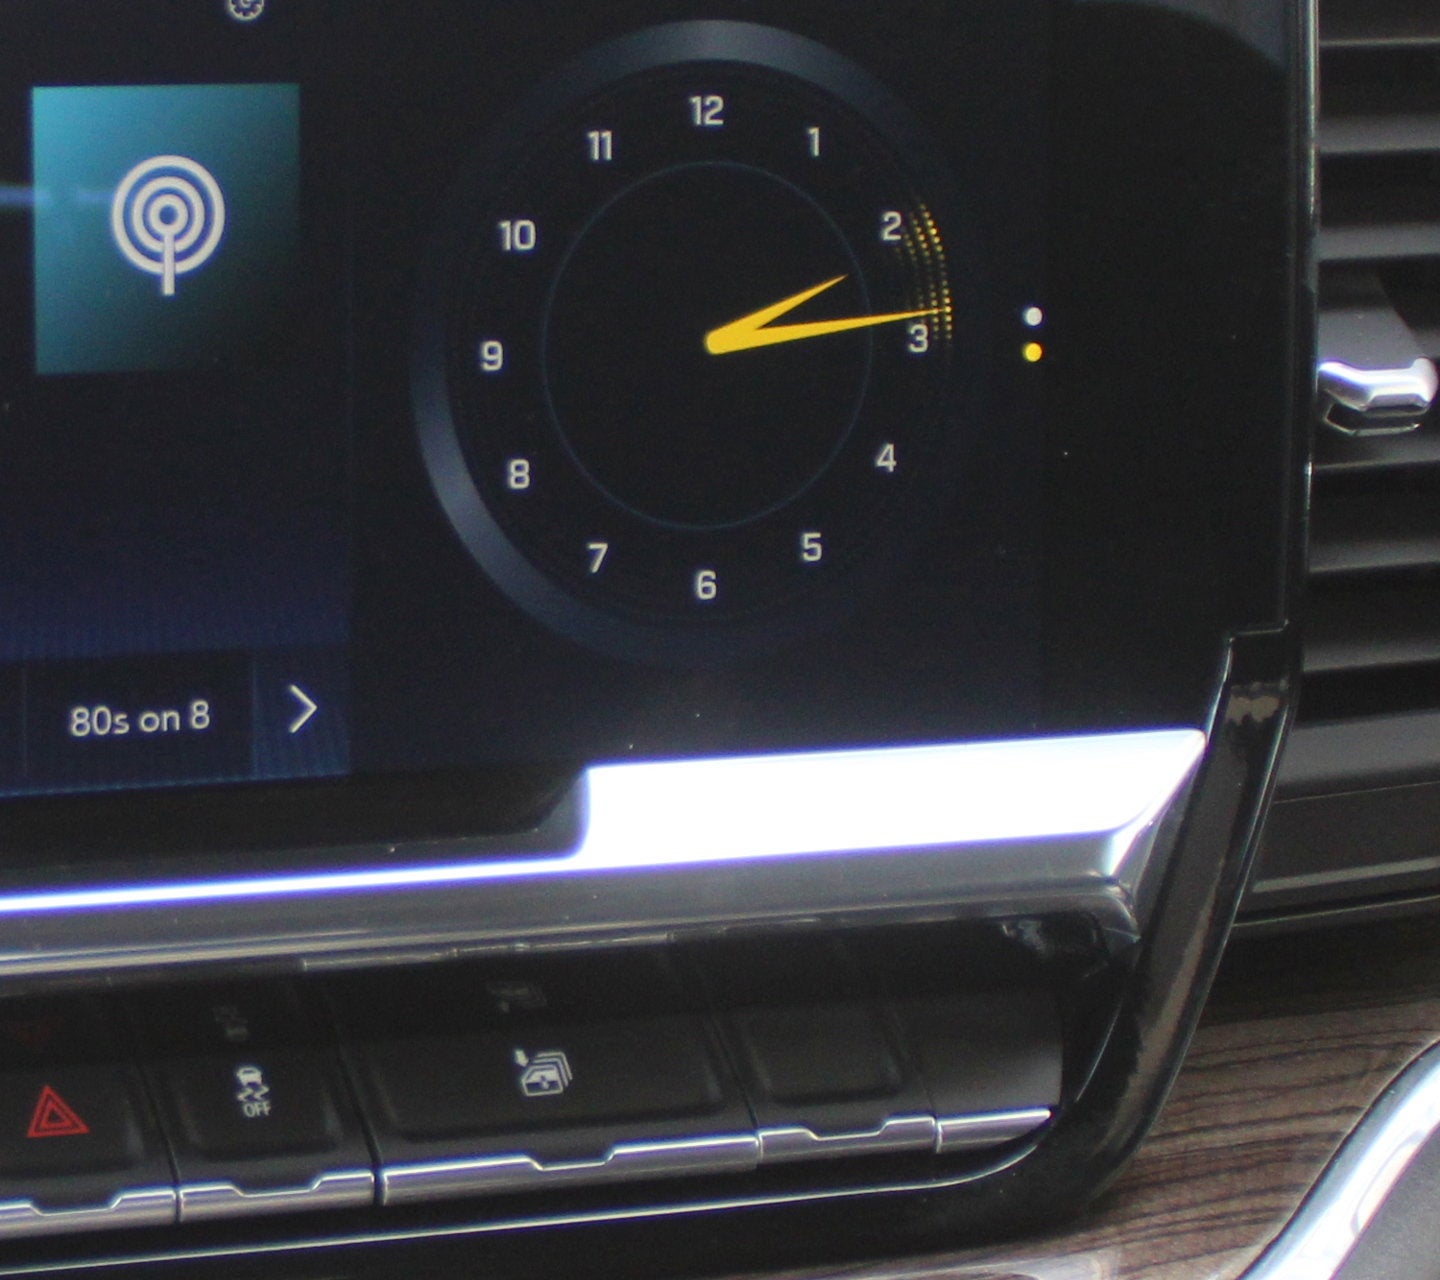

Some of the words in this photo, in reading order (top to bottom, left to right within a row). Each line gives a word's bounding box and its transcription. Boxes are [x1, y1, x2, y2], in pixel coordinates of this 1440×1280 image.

[689, 94, 724, 126] 12
[587, 130, 613, 161] 11
[807, 126, 820, 157] 1
[498, 219, 536, 251] 10
[881, 210, 903, 242] 2
[908, 322, 930, 354] 3
[480, 340, 504, 372] 9
[875, 443, 898, 473] 4
[507, 458, 530, 490] 8
[587, 542, 610, 573] 7
[801, 531, 823, 562] 5
[695, 569, 718, 600] 6
[69, 705, 130, 738] 80s
[138, 710, 181, 733] on
[189, 699, 211, 730] 8
[243, 1100, 271, 1118] OFF
